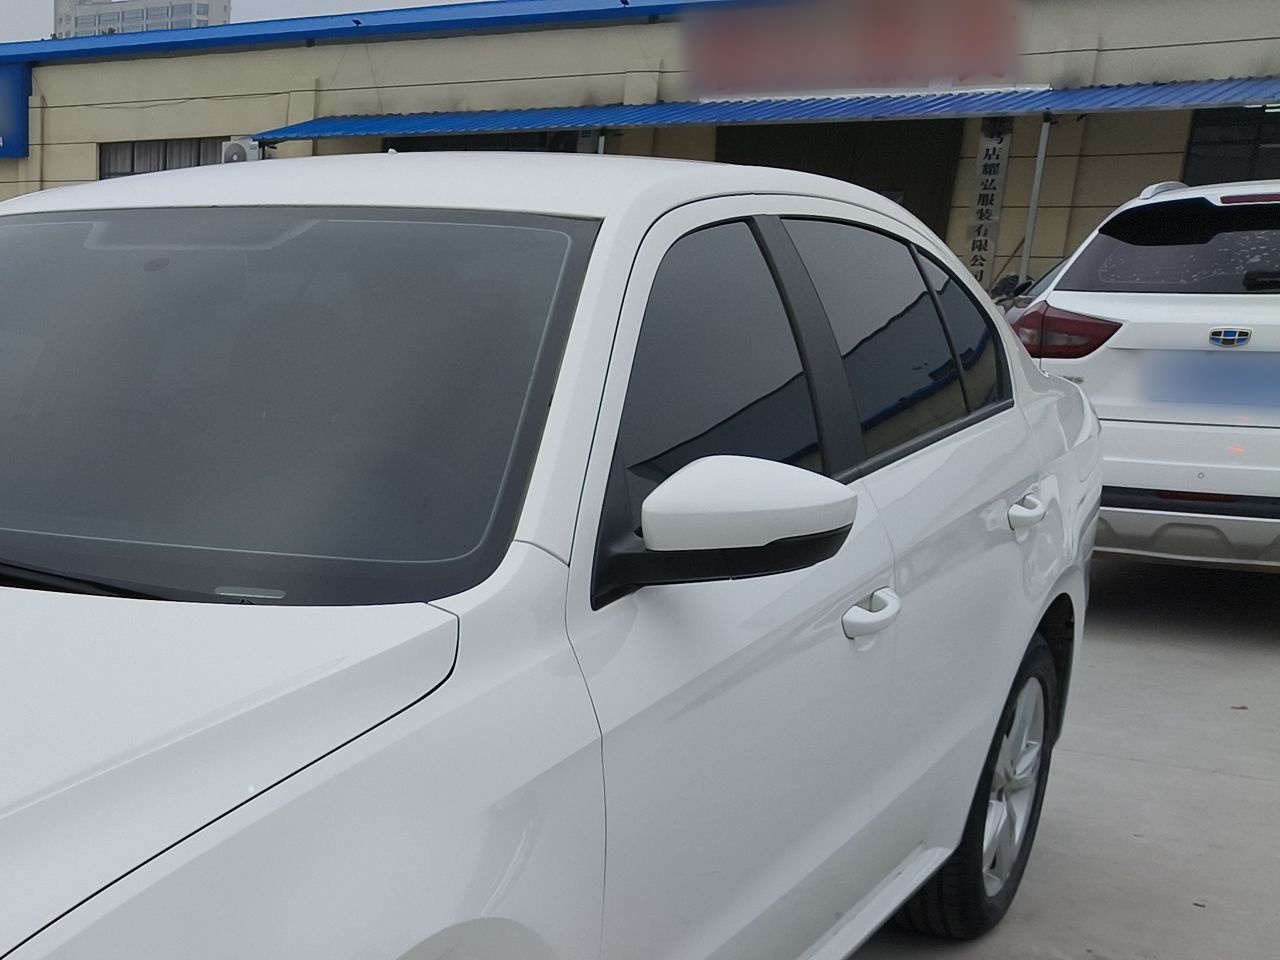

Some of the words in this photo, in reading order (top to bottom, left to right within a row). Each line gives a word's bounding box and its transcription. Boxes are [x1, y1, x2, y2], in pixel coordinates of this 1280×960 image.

[970, 119, 1005, 283] 马店耀弘服装有限公司
